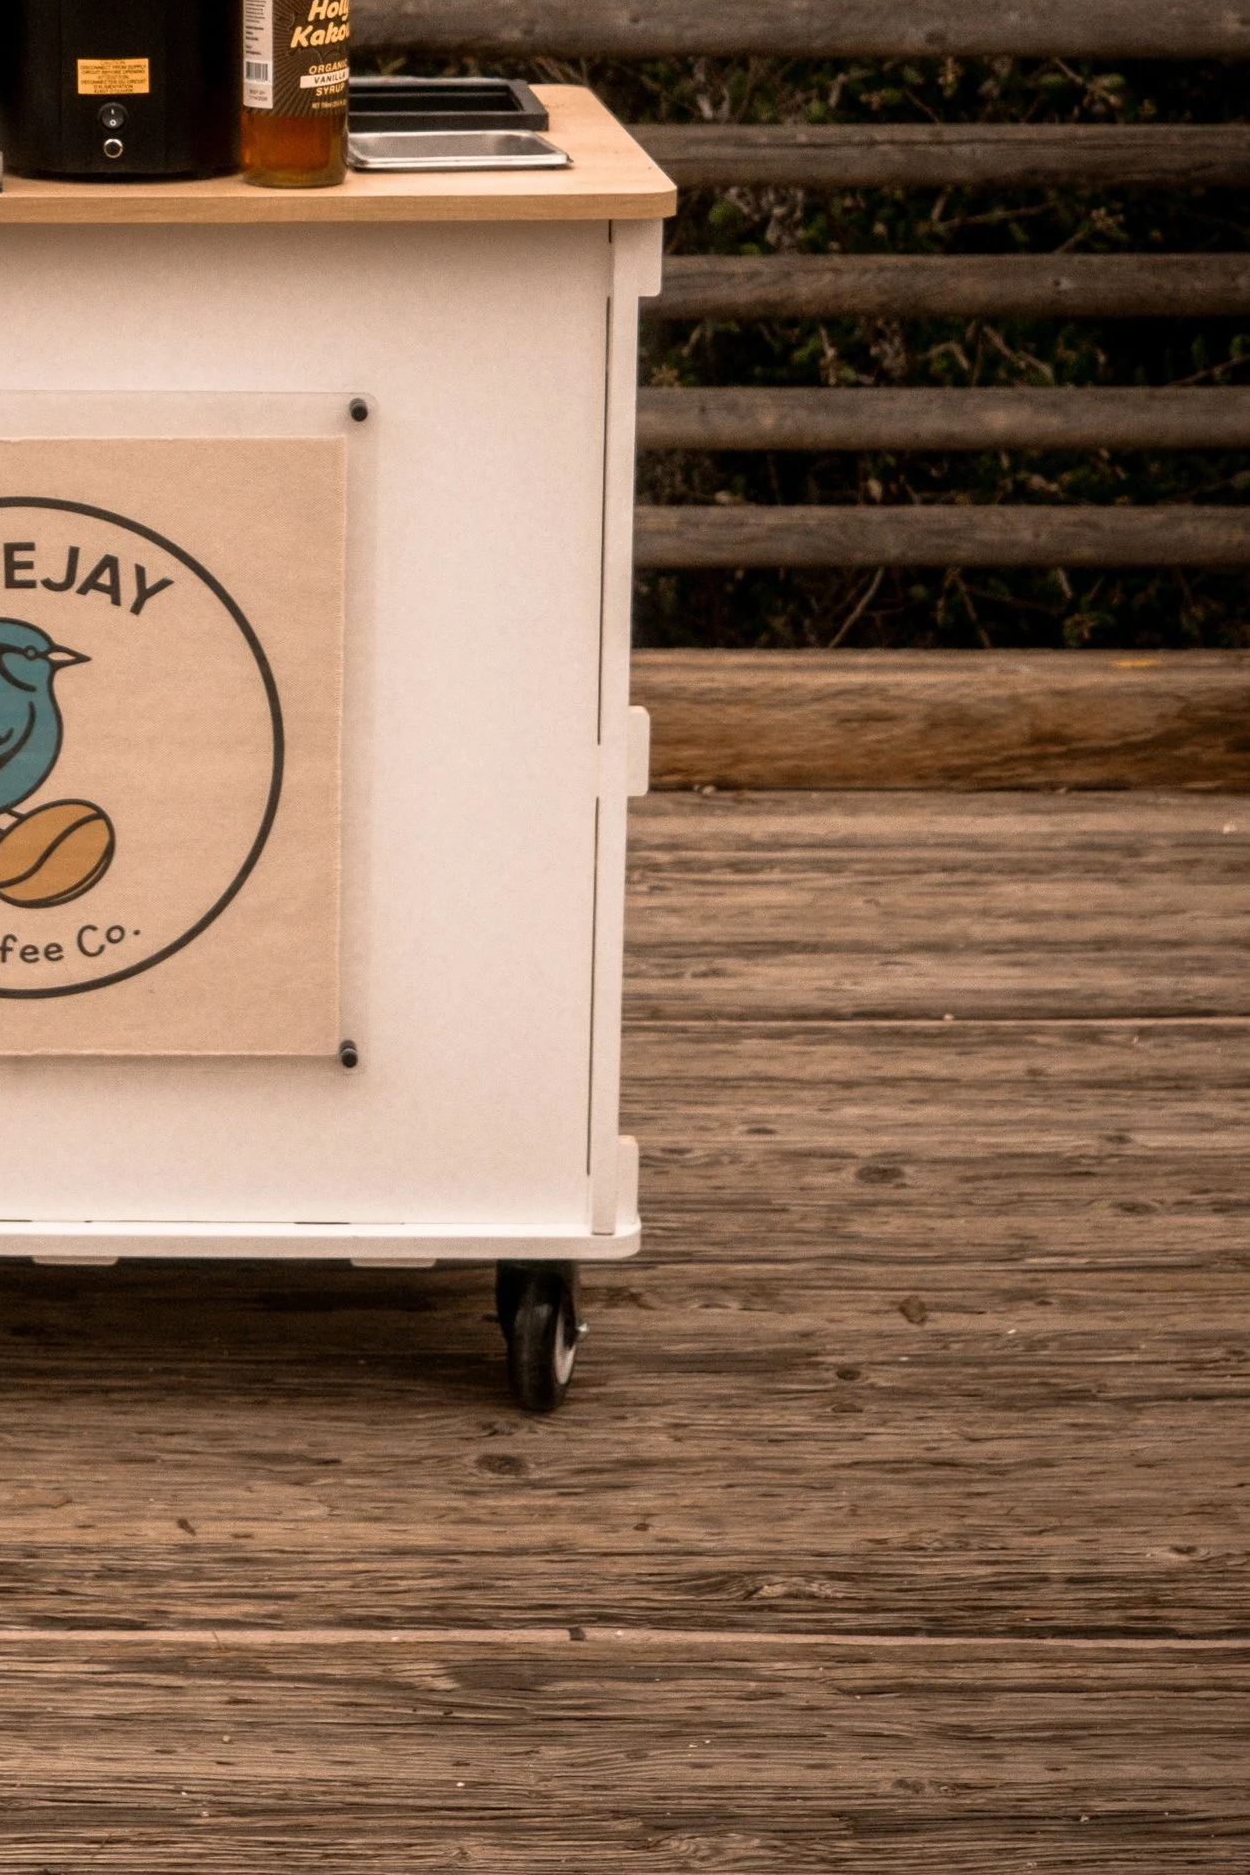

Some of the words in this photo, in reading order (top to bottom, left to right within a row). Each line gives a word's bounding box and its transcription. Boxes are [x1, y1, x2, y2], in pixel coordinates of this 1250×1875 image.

[314, 70, 347, 85] VANILLA
[315, 82, 345, 97] SYRUP
[76, 924, 141, 958] Co.
